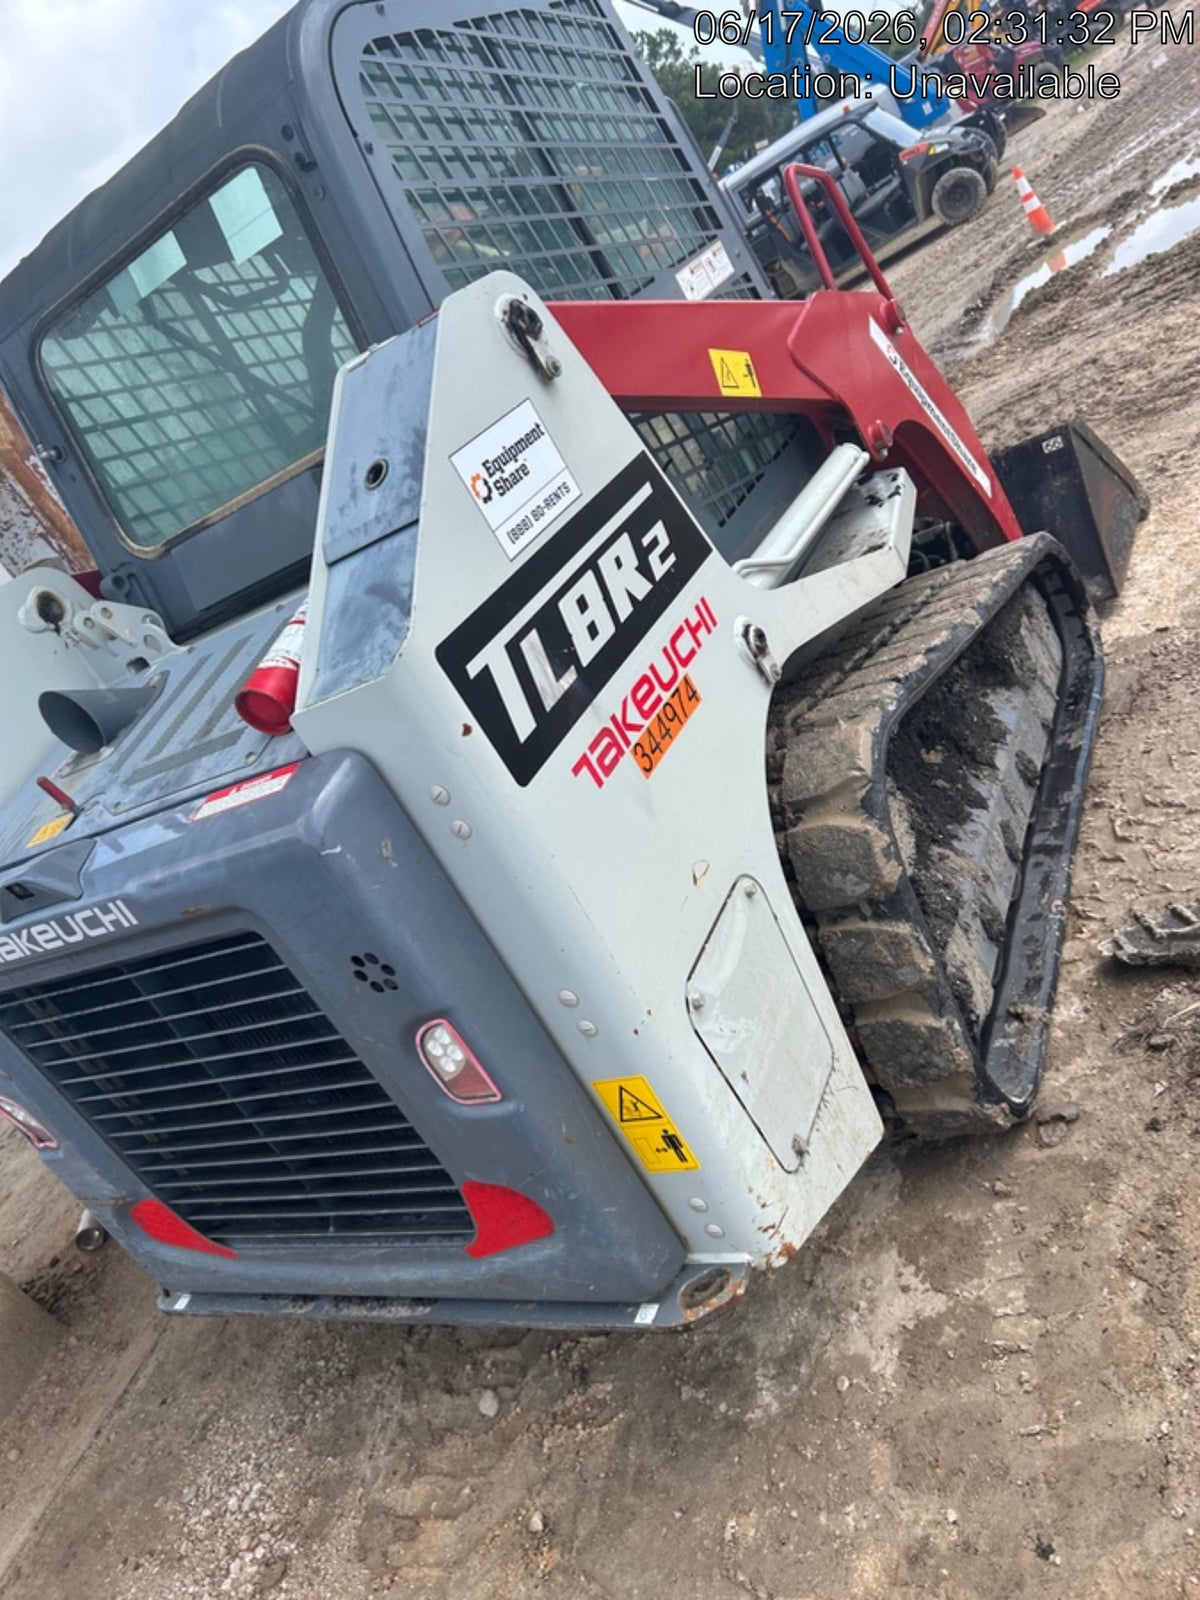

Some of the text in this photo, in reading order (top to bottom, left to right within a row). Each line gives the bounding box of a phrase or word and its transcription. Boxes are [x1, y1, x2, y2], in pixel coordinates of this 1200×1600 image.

[481, 422, 545, 478] Equipment
[493, 462, 531, 497] Share
[506, 515, 534, 544] (888)
[632, 676, 700, 773] 344974
